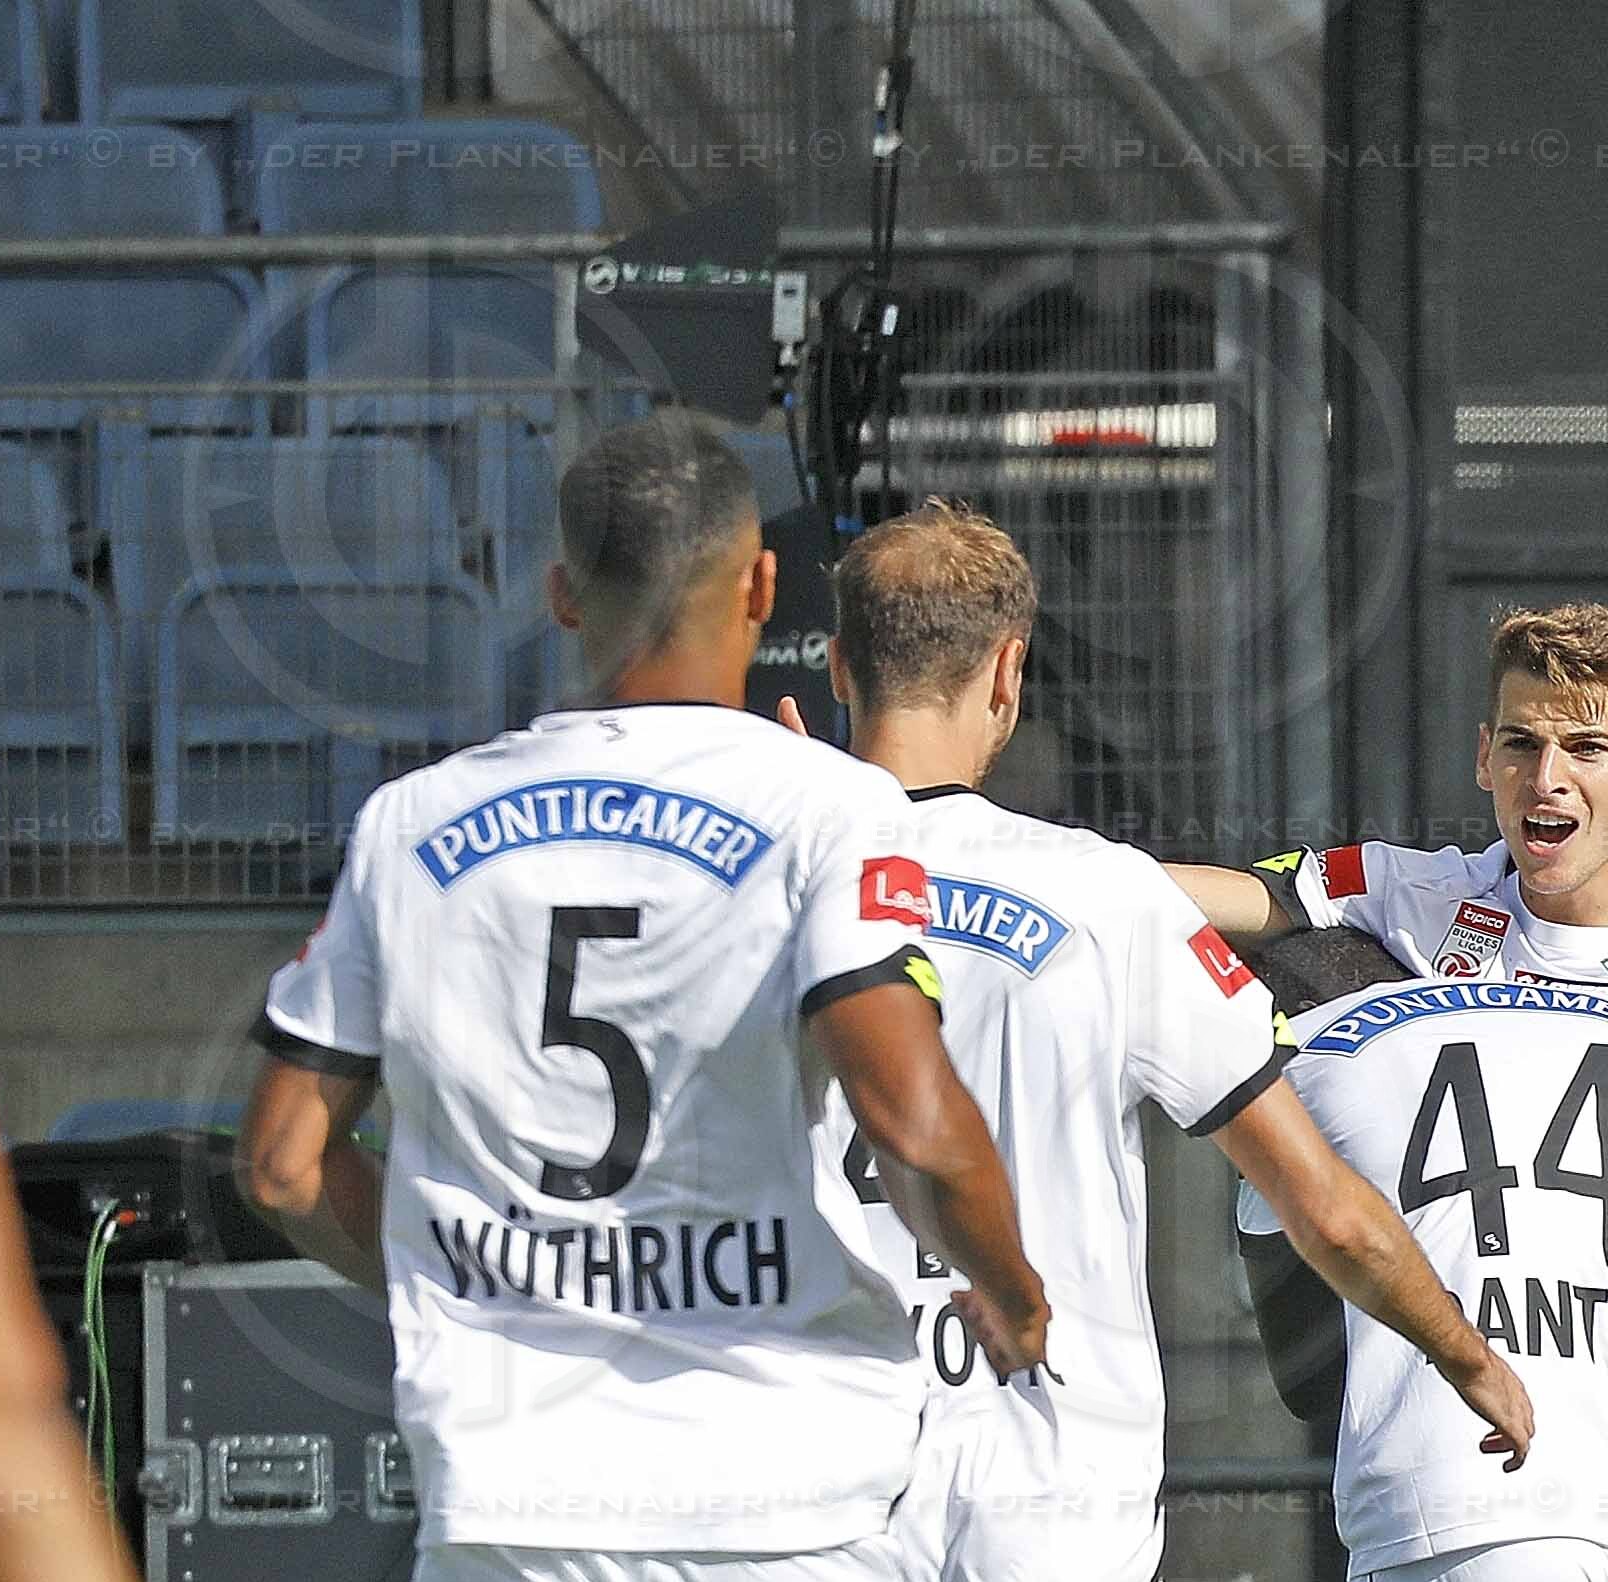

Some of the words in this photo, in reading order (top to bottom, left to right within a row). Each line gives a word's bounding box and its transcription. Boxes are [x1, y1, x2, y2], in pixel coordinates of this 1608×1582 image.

[430, 785, 758, 876] PUNTIGAMER
[1452, 928, 1499, 949] BUNDES
[1463, 907, 1505, 929] tipico
[1458, 938, 1484, 955] LIGA
[540, 906, 651, 1201] 5
[429, 1203, 789, 1312] WÜTHRICH
